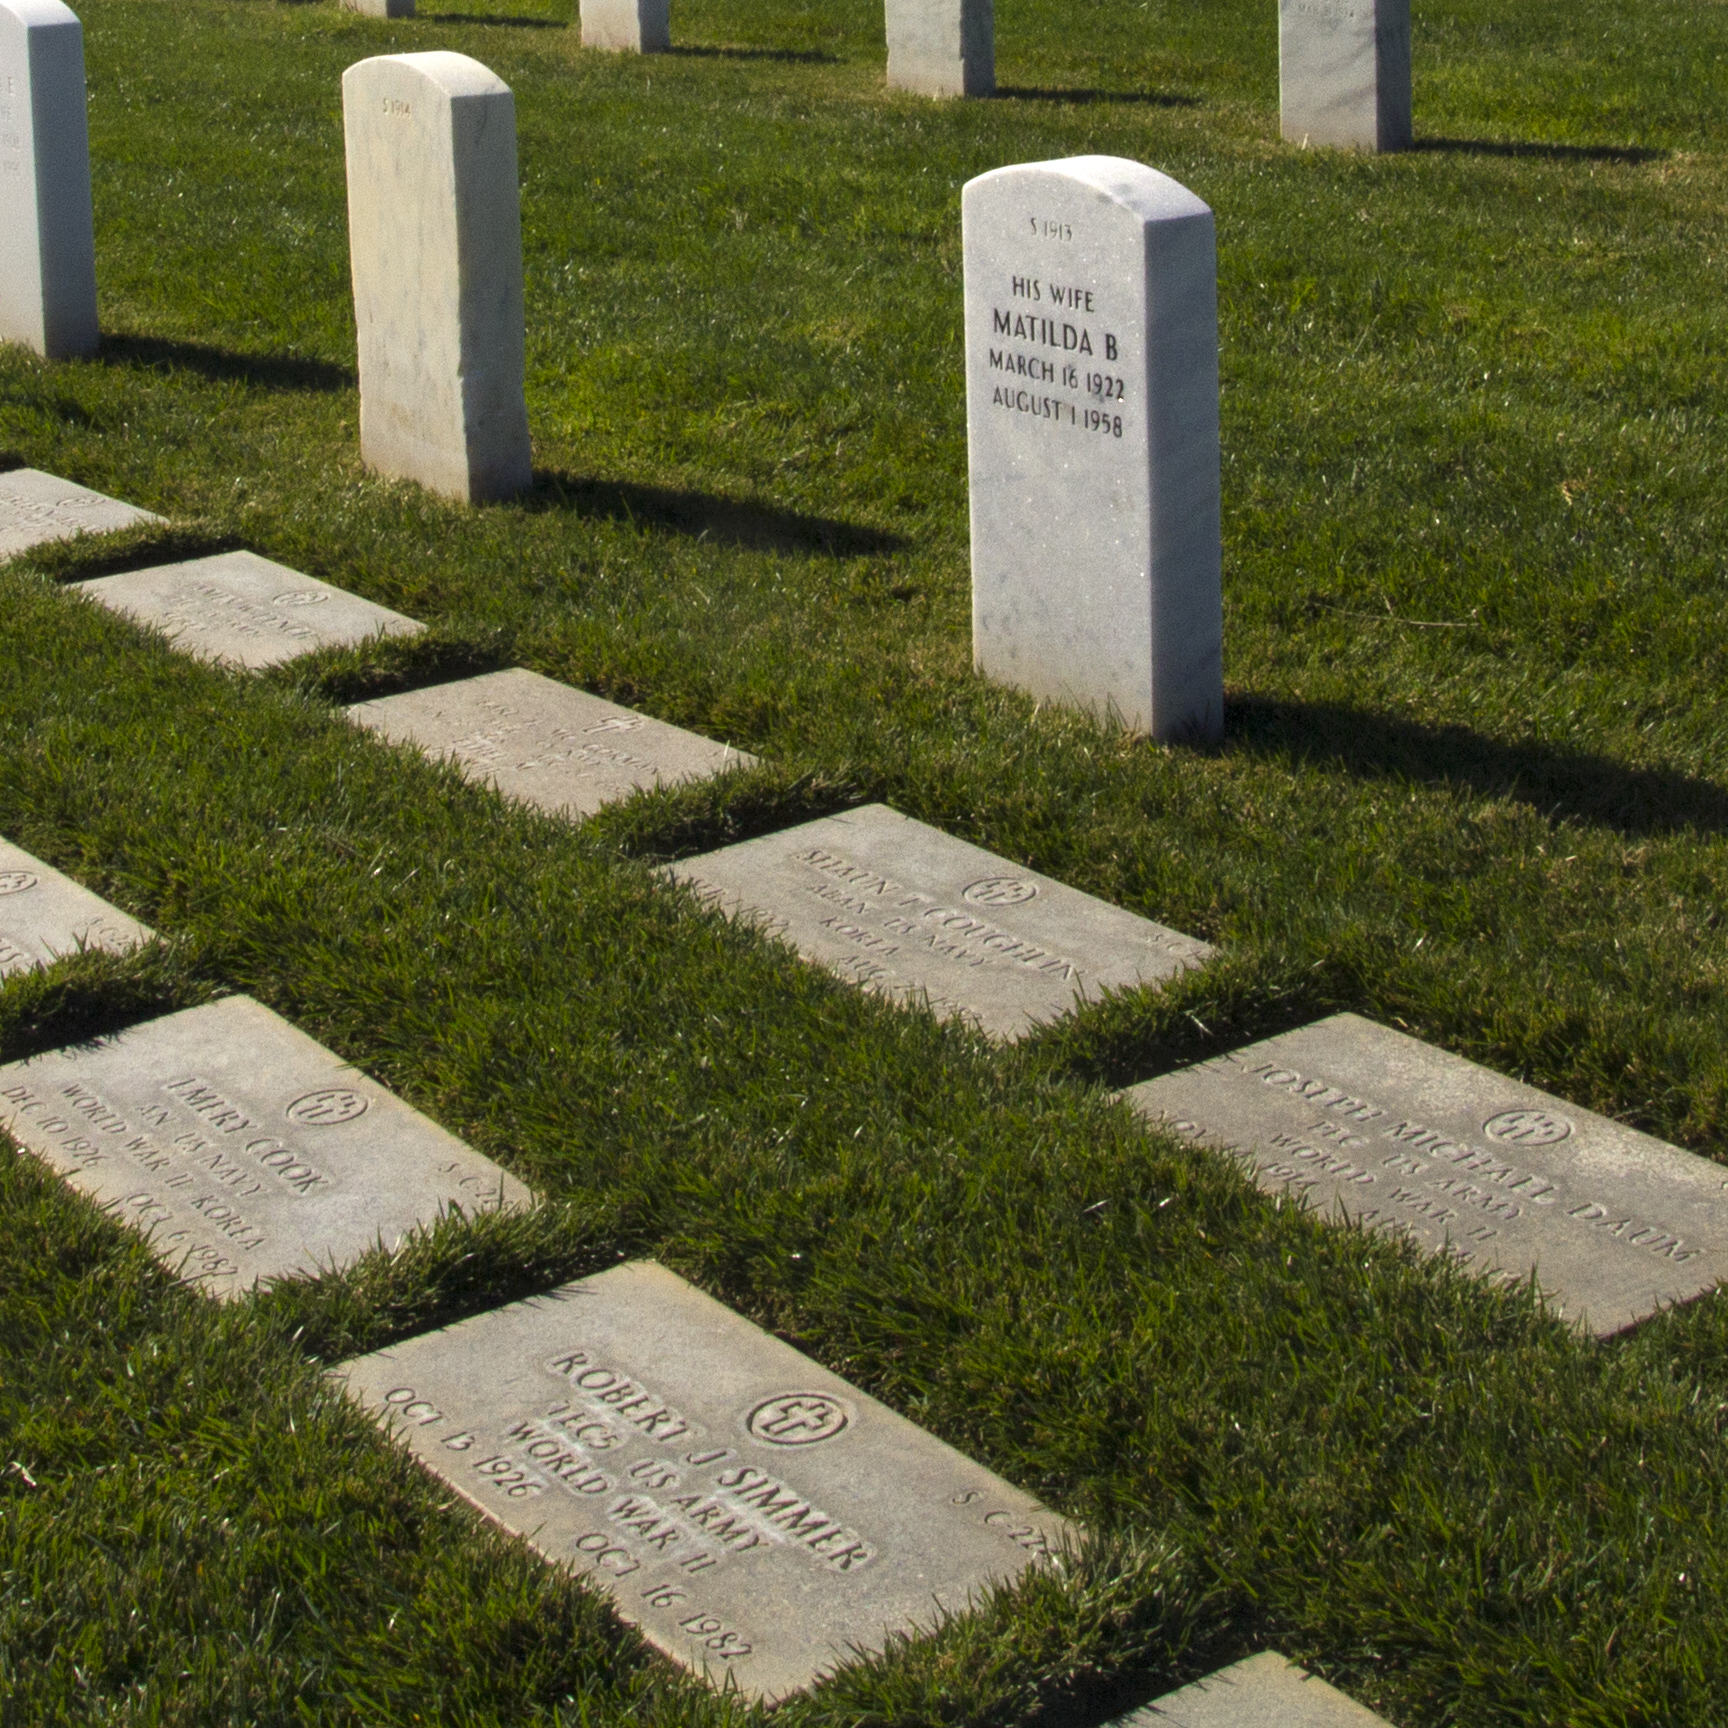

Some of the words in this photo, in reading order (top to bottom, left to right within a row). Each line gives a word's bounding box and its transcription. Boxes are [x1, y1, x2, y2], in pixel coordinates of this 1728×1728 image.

[8, 77, 13, 94] E
[382, 98, 388, 114] S
[390, 101, 412, 118] 1914
[1030, 217, 1039, 236] S
[1043, 220, 1073, 242] 1913
[1012, 275, 1041, 302] HIS
[1049, 284, 1095, 313] WIFE
[992, 308, 1093, 356] MATILDA
[1105, 333, 1119, 361] B
[989, 349, 1054, 385] MARCH
[1062, 366, 1079, 390] 16
[1086, 372, 1125, 400] 1922
[992, 386, 1061, 422] AUGUST
[1070, 403, 1076, 426] 1
[1084, 406, 1123, 438] 1958
[792, 848, 901, 896] SHAUN
[919, 905, 1085, 983] COUGHLIN
[819, 915, 903, 957] KOREA
[882, 918, 918, 934] US
[918, 934, 991, 969] NAVY
[0, 1086, 49, 1115] DEC
[36, 1116, 71, 1134] 10
[59, 1136, 111, 1167] 1926
[121, 1192, 177, 1225] OCT
[53, 1084, 133, 1136] WORLD
[118, 1137, 176, 1171] WAR
[164, 1174, 194, 1187] II
[186, 1194, 273, 1250] KOREA
[172, 1132, 211, 1153] US
[197, 1154, 269, 1198] NAVY
[238, 1135, 338, 1195] COOK
[1239, 1058, 1387, 1124] JOSEPH
[1381, 1121, 1567, 1206] MICHAEL
[1564, 1201, 1705, 1265] DAUM
[1263, 1132, 1380, 1188] WORLD
[1382, 1188, 1459, 1224] WAR
[1464, 1225, 1499, 1241] II
[1379, 1154, 1427, 1176] US
[1426, 1175, 1528, 1222] ARMY
[544, 1402, 624, 1451] TEC5
[627, 1461, 678, 1490] US
[669, 1491, 769, 1556] ARMY
[547, 1351, 699, 1445] ROBERT
[712, 1465, 880, 1572] SIMMER
[382, 1386, 448, 1427] OCT
[440, 1430, 481, 1453] 13
[472, 1455, 542, 1498] 1926
[571, 1530, 644, 1578] OCT
[640, 1583, 686, 1609] 16
[498, 1421, 615, 1498] WORLD
[605, 1499, 686, 1552] WAR
[678, 1553, 718, 1575] II
